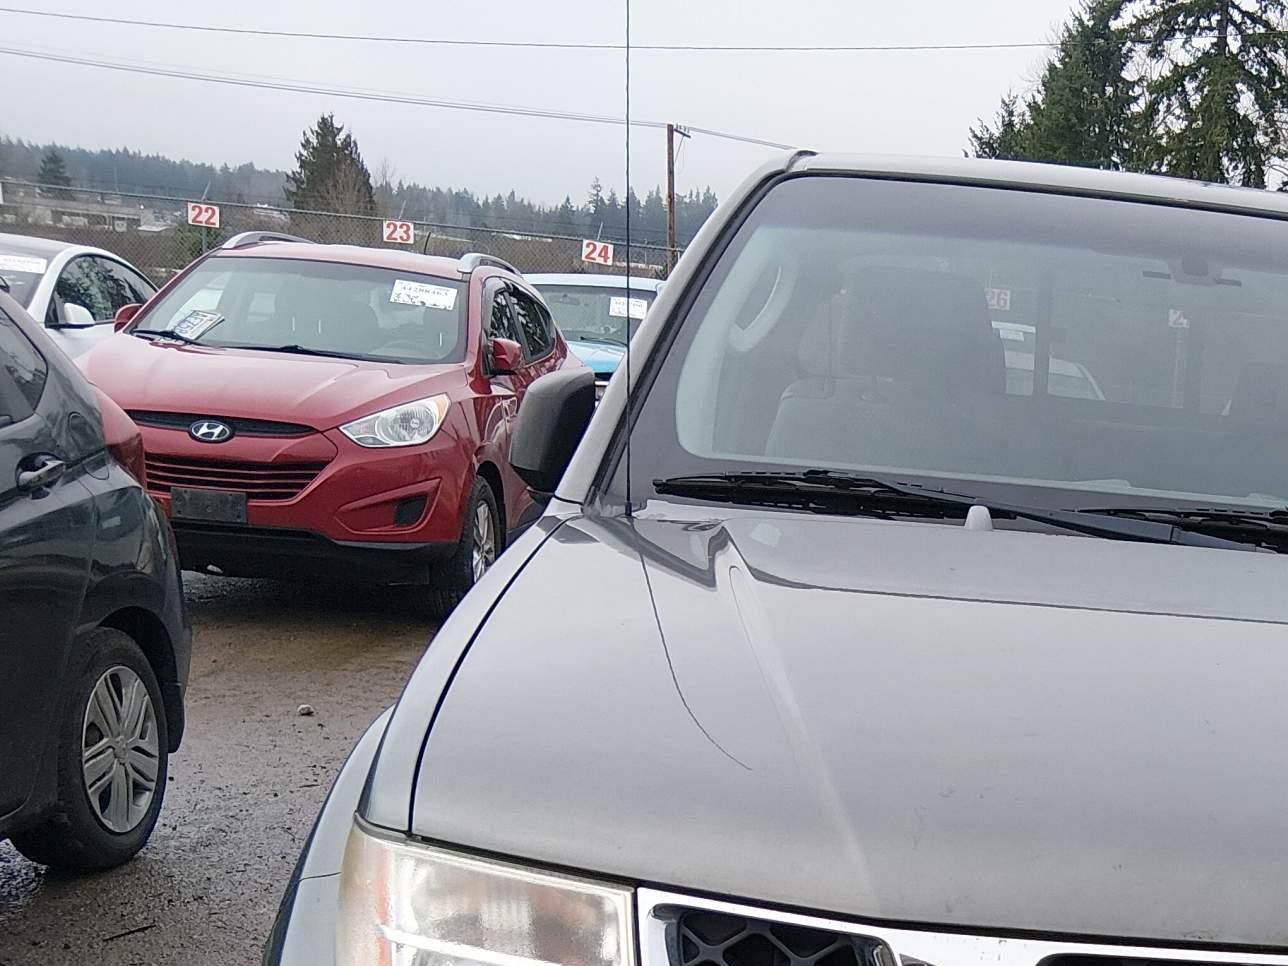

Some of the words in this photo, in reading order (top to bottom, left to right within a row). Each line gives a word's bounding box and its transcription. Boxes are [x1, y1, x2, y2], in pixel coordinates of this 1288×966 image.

[191, 204, 216, 226] 22
[386, 222, 411, 242] 23
[584, 242, 610, 263] 24
